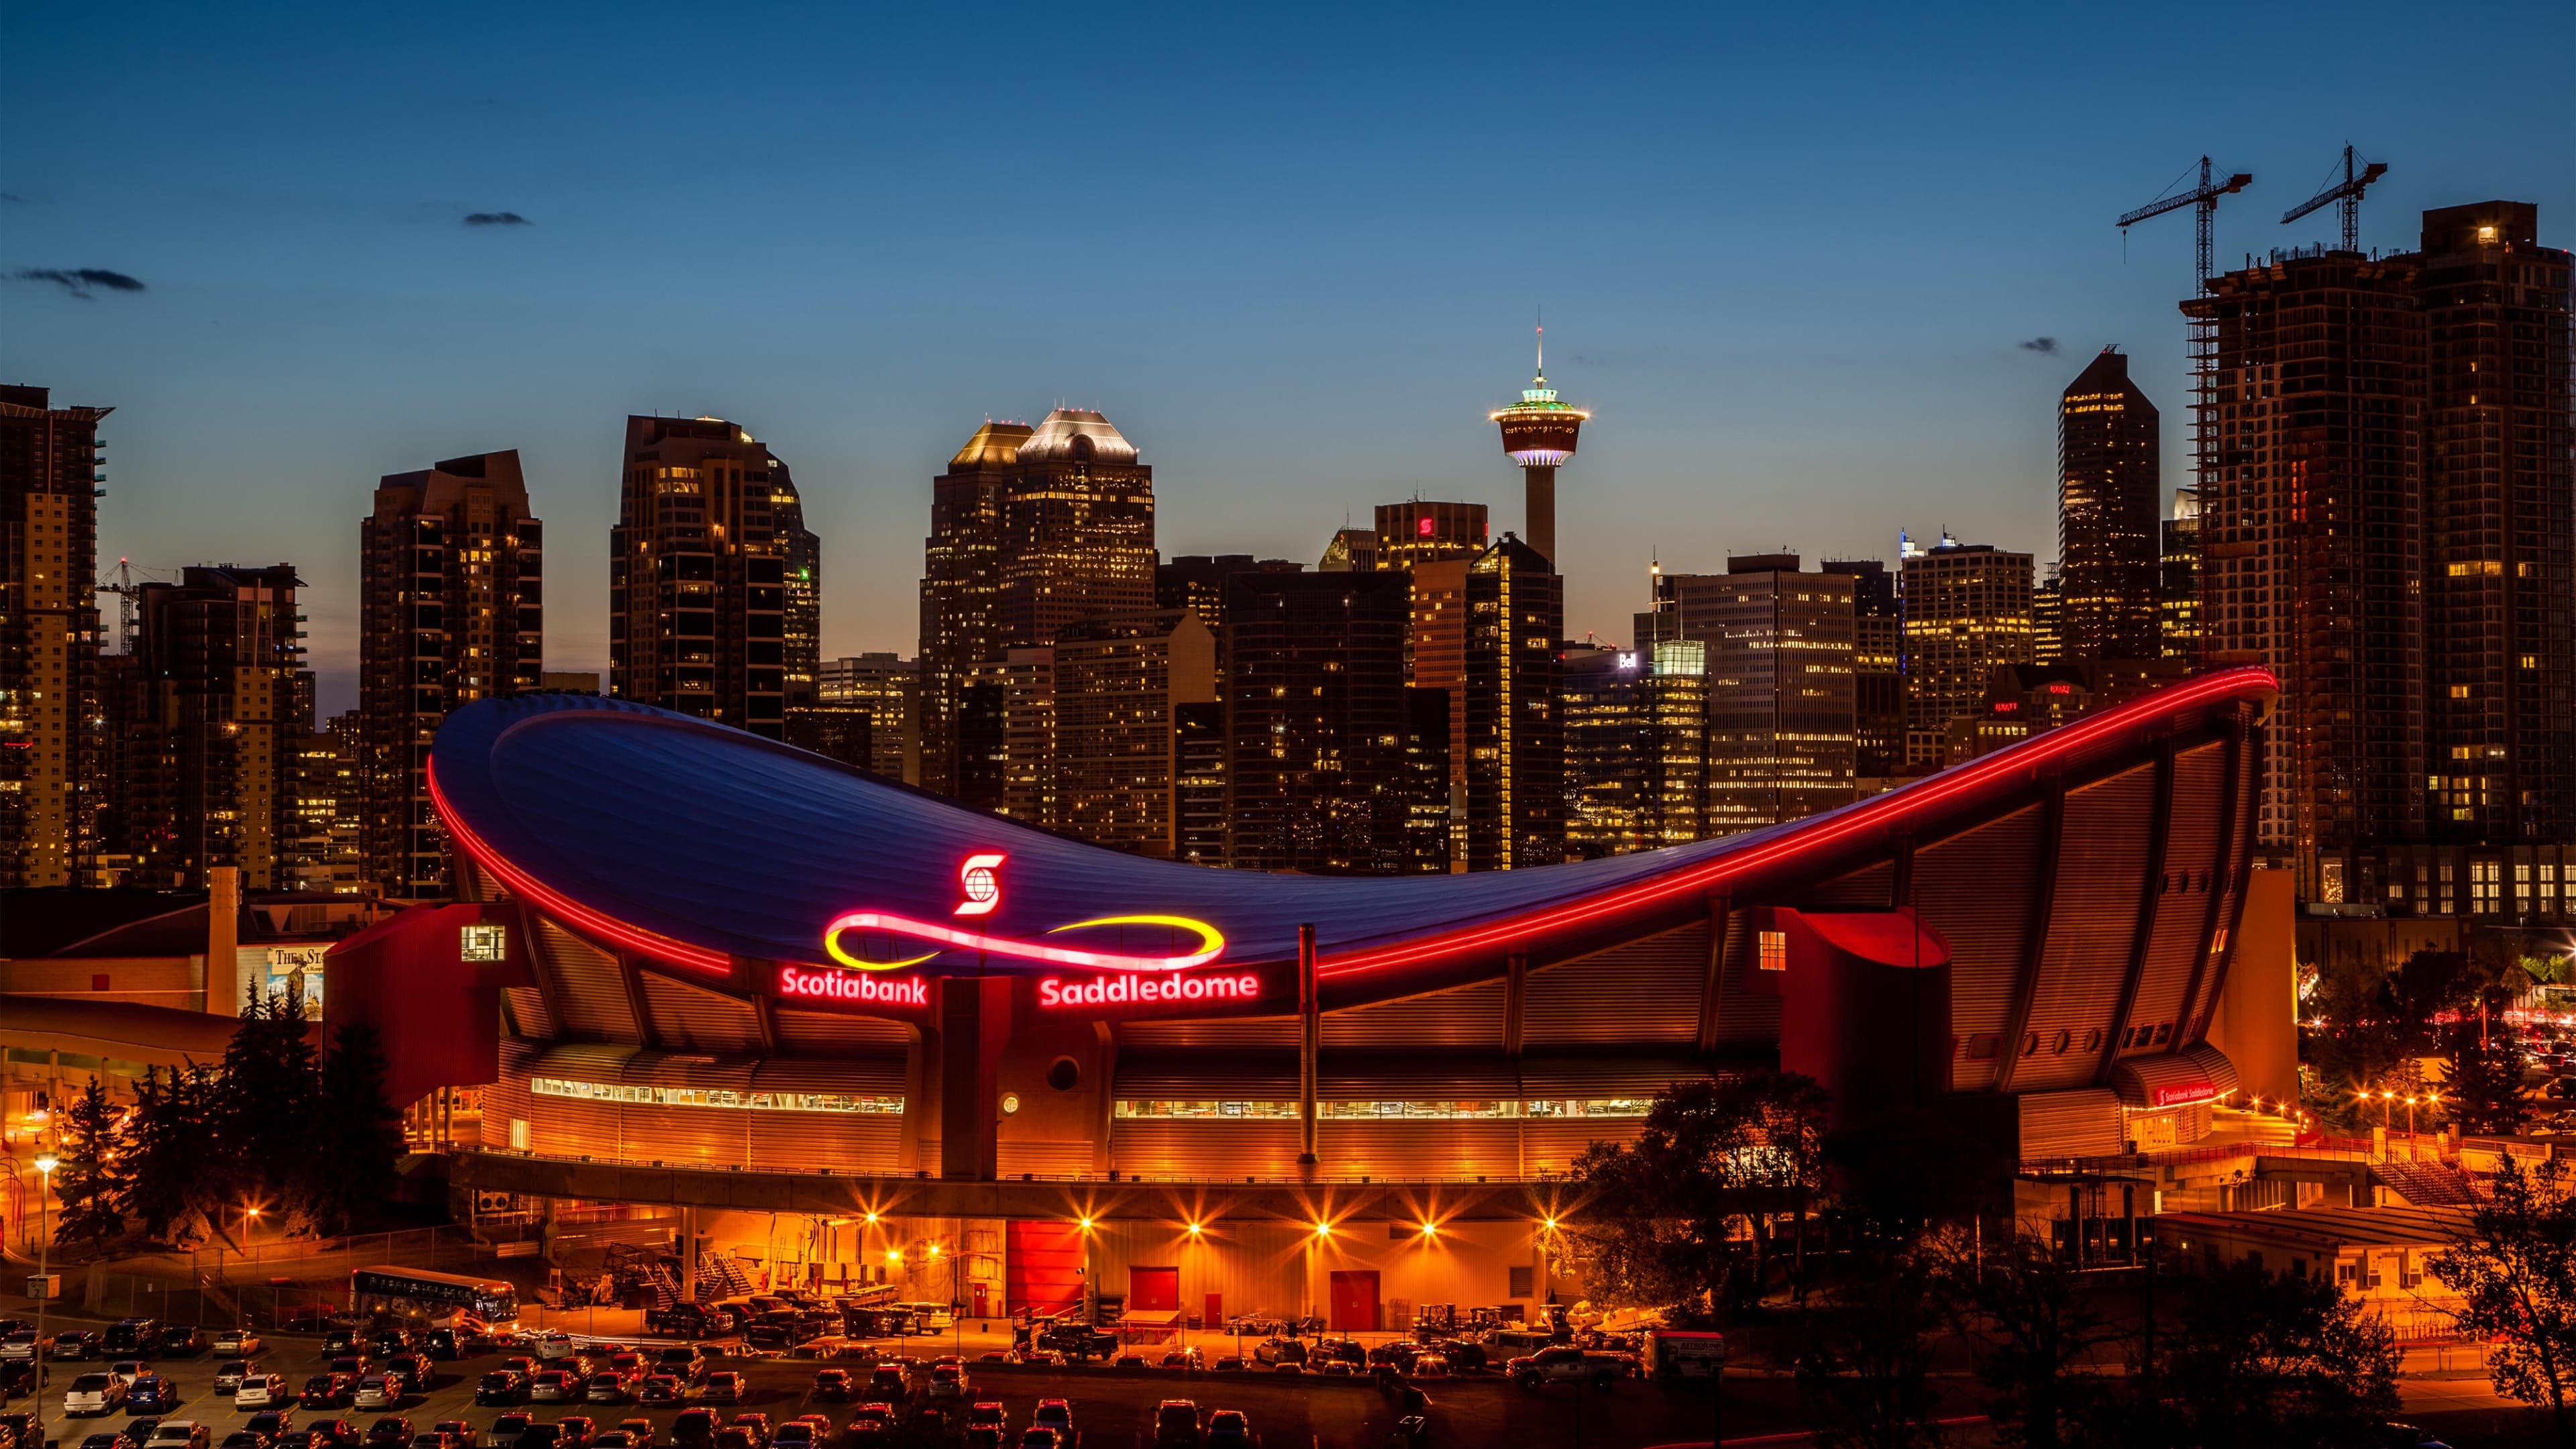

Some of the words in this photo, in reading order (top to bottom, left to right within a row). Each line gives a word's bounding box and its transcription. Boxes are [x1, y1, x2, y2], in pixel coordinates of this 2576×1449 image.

[1619, 653, 1636, 668] Bell
[2049, 685, 2071, 694] HYATT
[1995, 702, 2018, 712] HYATT
[307, 949, 323, 964] ST
[782, 967, 927, 1004] Scotiabank
[1040, 973, 1258, 1006] Saddledome
[2165, 1089, 2189, 1102] Scotiabank
[2189, 1087, 2214, 1098] Saddledome
